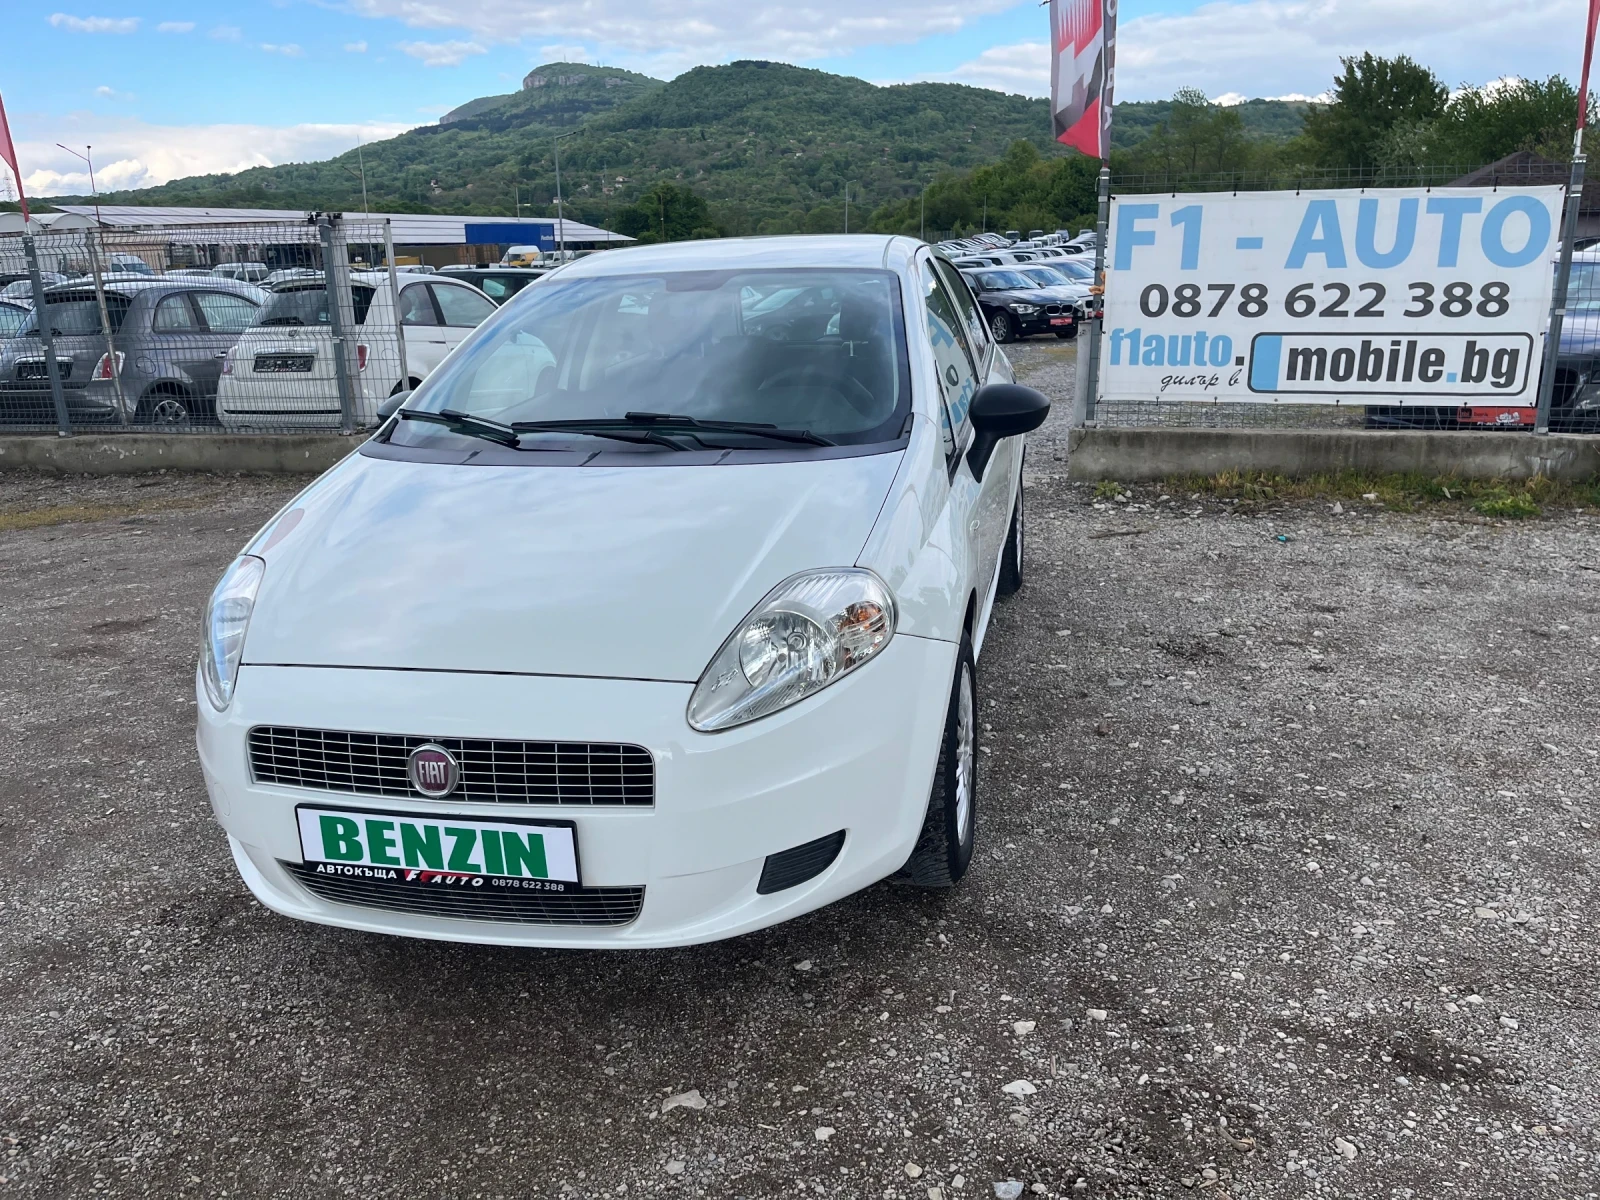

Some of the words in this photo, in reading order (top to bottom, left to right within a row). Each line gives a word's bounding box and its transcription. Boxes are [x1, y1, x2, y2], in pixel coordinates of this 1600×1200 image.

[1114, 203, 1203, 270] F1
[1236, 237, 1263, 249] -
[1284, 195, 1551, 269] AUTO
[1140, 283, 1268, 317] 0878
[1284, 282, 1387, 318] 622
[1403, 281, 1510, 318] 388
[1286, 340, 1520, 388] mobile.bg
[1160, 373, 1219, 391] дилър
[418, 761, 446, 784] FIAT
[319, 815, 549, 879] BENZIN
[316, 863, 398, 879] АВТОКЪЩА
[431, 874, 484, 887] AUTO
[491, 878, 520, 888] 0878
[522, 880, 542, 890] 622
[544, 882, 565, 892] 388
